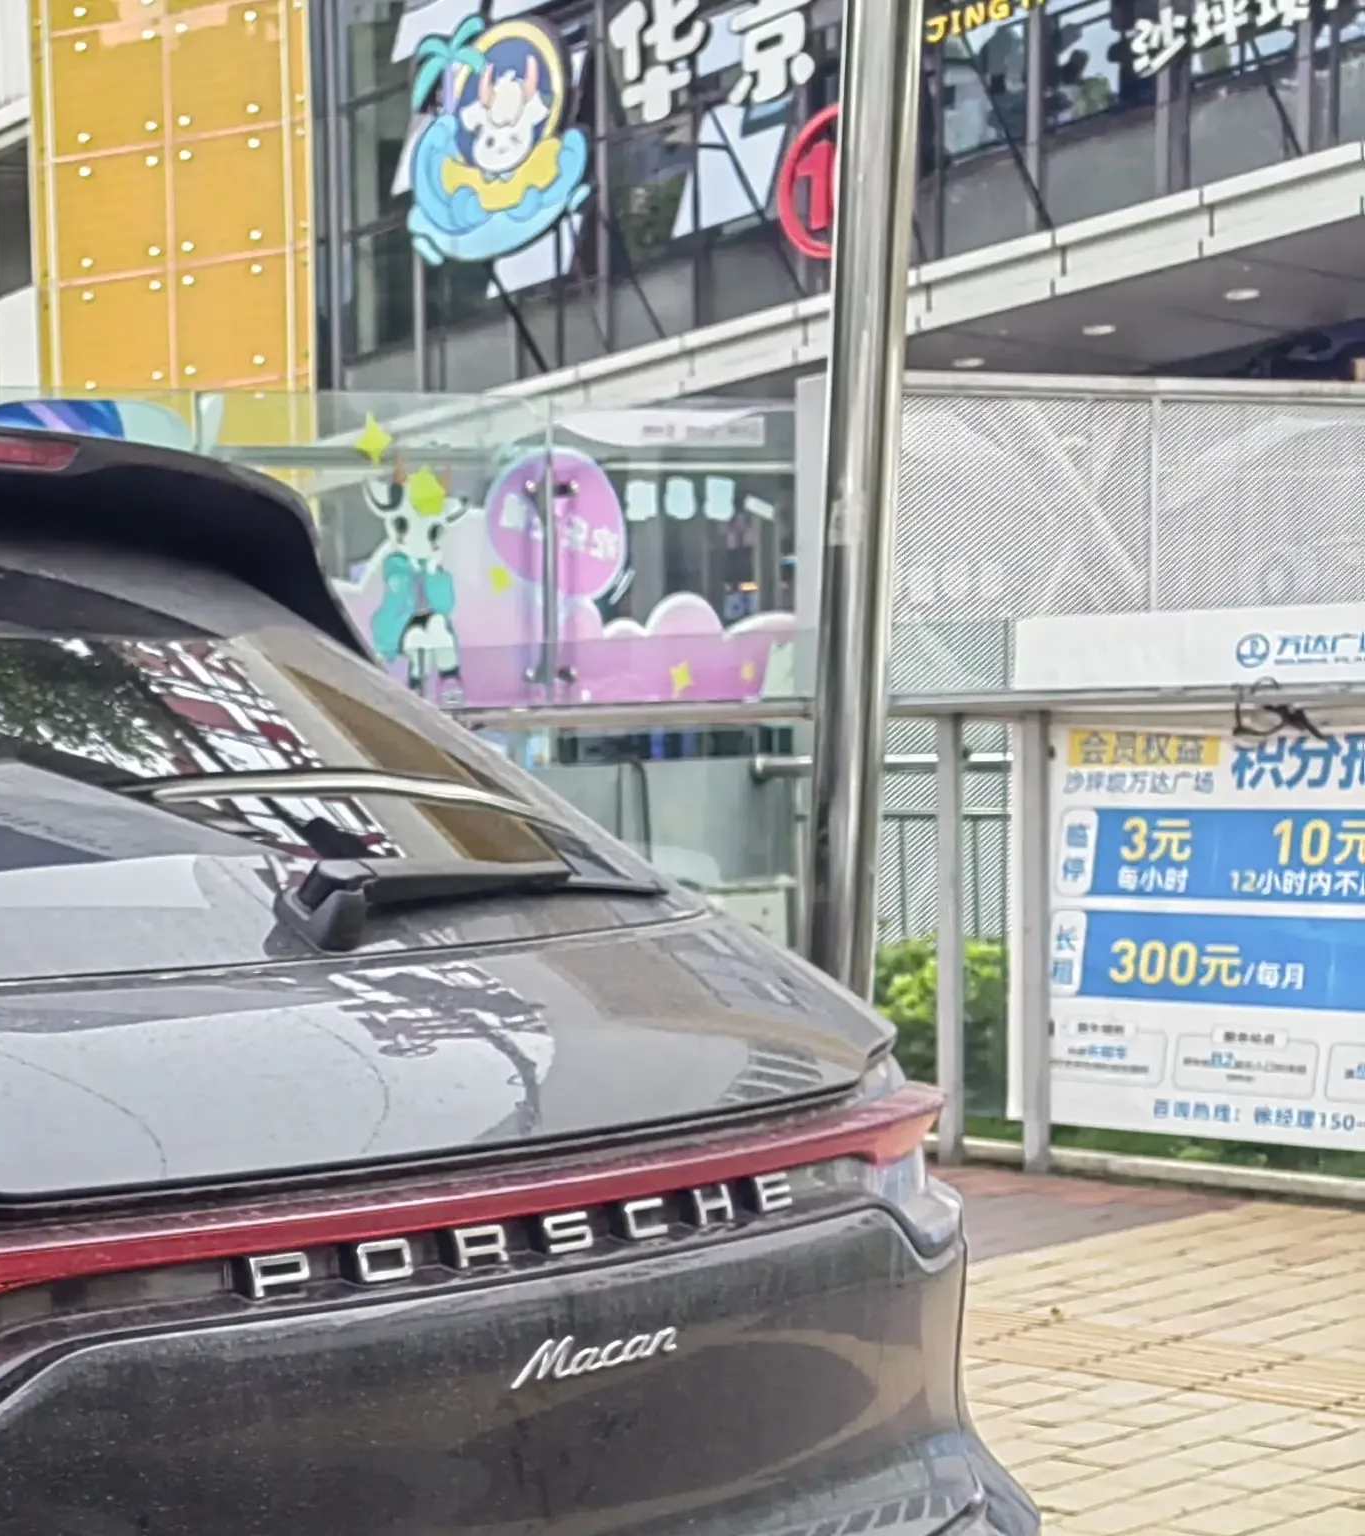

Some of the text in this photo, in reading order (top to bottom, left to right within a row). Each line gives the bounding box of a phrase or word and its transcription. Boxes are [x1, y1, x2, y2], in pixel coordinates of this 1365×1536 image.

[925, 0, 1011, 43] JING
[609, 0, 815, 122] 华京
[1276, 633, 1365, 656] 万达广
[1120, 816, 1193, 863] 3元
[1117, 865, 1189, 893] 每小时
[1230, 868, 1365, 896] 12小时内不
[249, 1172, 793, 1299] PORSCHE
[510, 1325, 678, 1391] Macan
